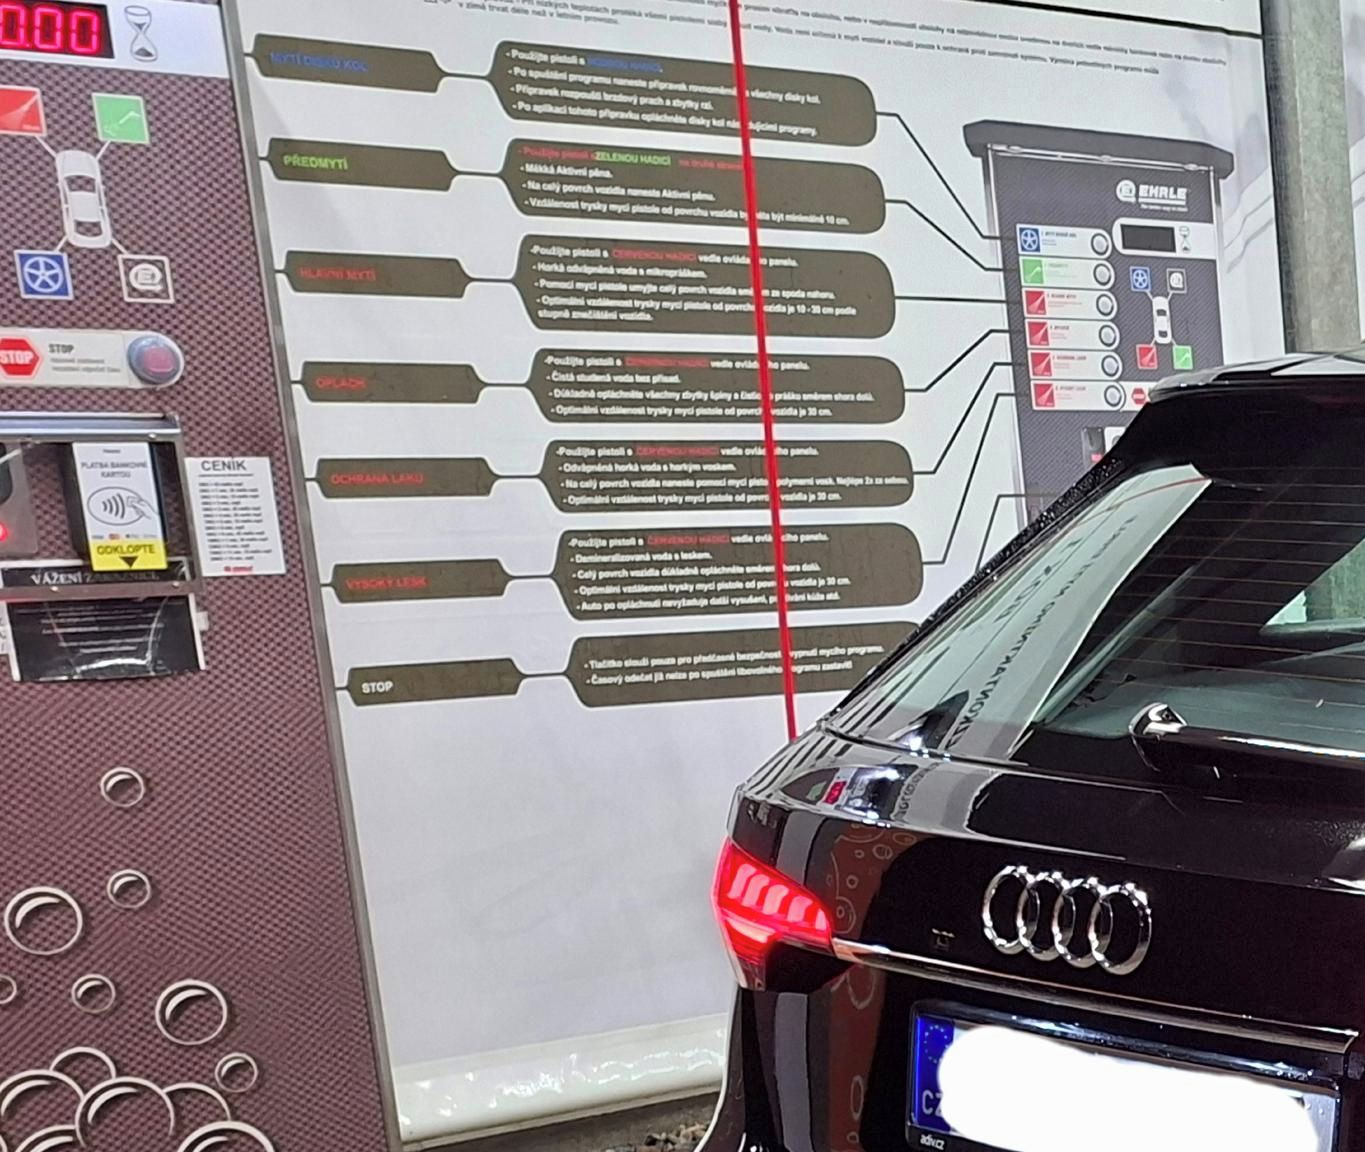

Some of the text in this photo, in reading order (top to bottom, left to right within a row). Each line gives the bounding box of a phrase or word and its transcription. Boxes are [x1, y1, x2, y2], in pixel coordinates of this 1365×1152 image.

[283, 154, 348, 171] PŘEDMYTÍ
[1139, 184, 1187, 200] EHRLE
[49, 344, 74, 354] STOP
[0, 350, 34, 364] STOP
[96, 544, 155, 556] ODKLOPTE
[32, 571, 82, 585] VÁŽENÍ
[362, 681, 394, 694] STOP
[920, 1134, 945, 1150] adiv.cz
